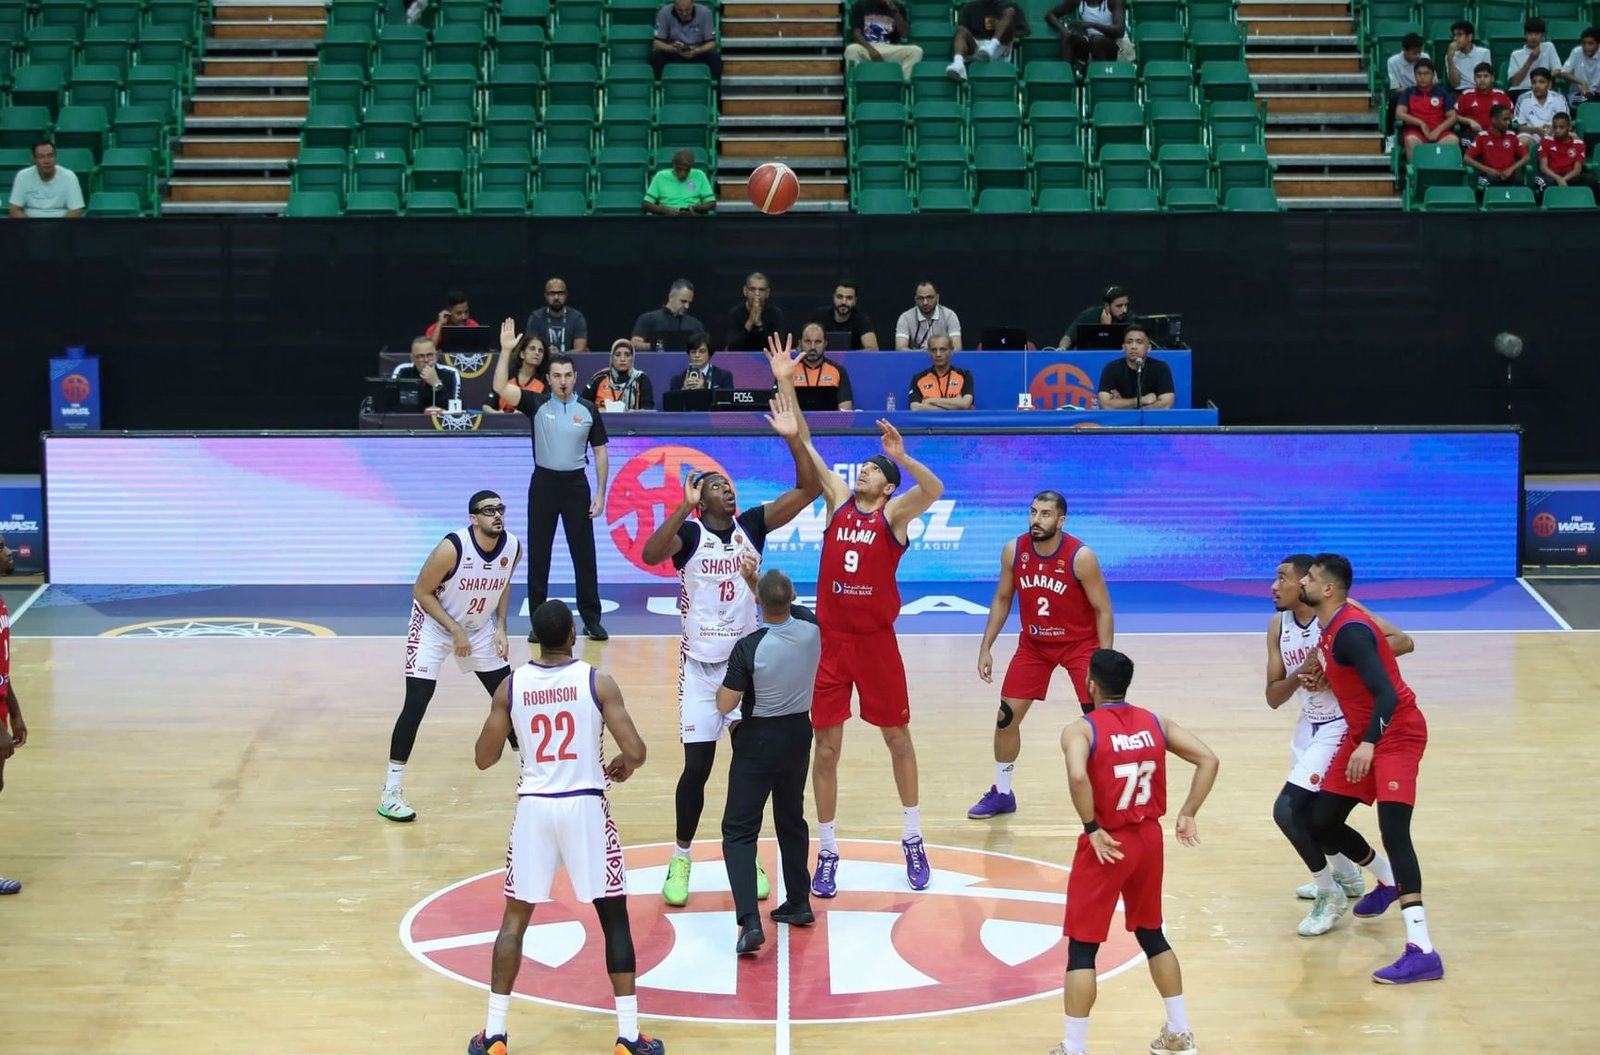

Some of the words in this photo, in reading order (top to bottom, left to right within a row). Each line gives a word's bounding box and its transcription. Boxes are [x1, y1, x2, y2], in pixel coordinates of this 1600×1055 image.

[1558, 522, 1596, 531] WASL
[767, 543, 806, 551] WEST
[914, 542, 960, 550] EAGUE
[701, 554, 745, 575] SHARJA
[844, 550, 859, 573] 9
[458, 578, 506, 590] SHARJAH
[719, 581, 735, 602] 13
[1020, 574, 1067, 595] ALARABI
[466, 597, 487, 615] 24
[1037, 597, 1050, 616] 2
[523, 686, 577, 706] ROBINSON
[530, 711, 577, 763] 22
[1113, 760, 1156, 811] 73
